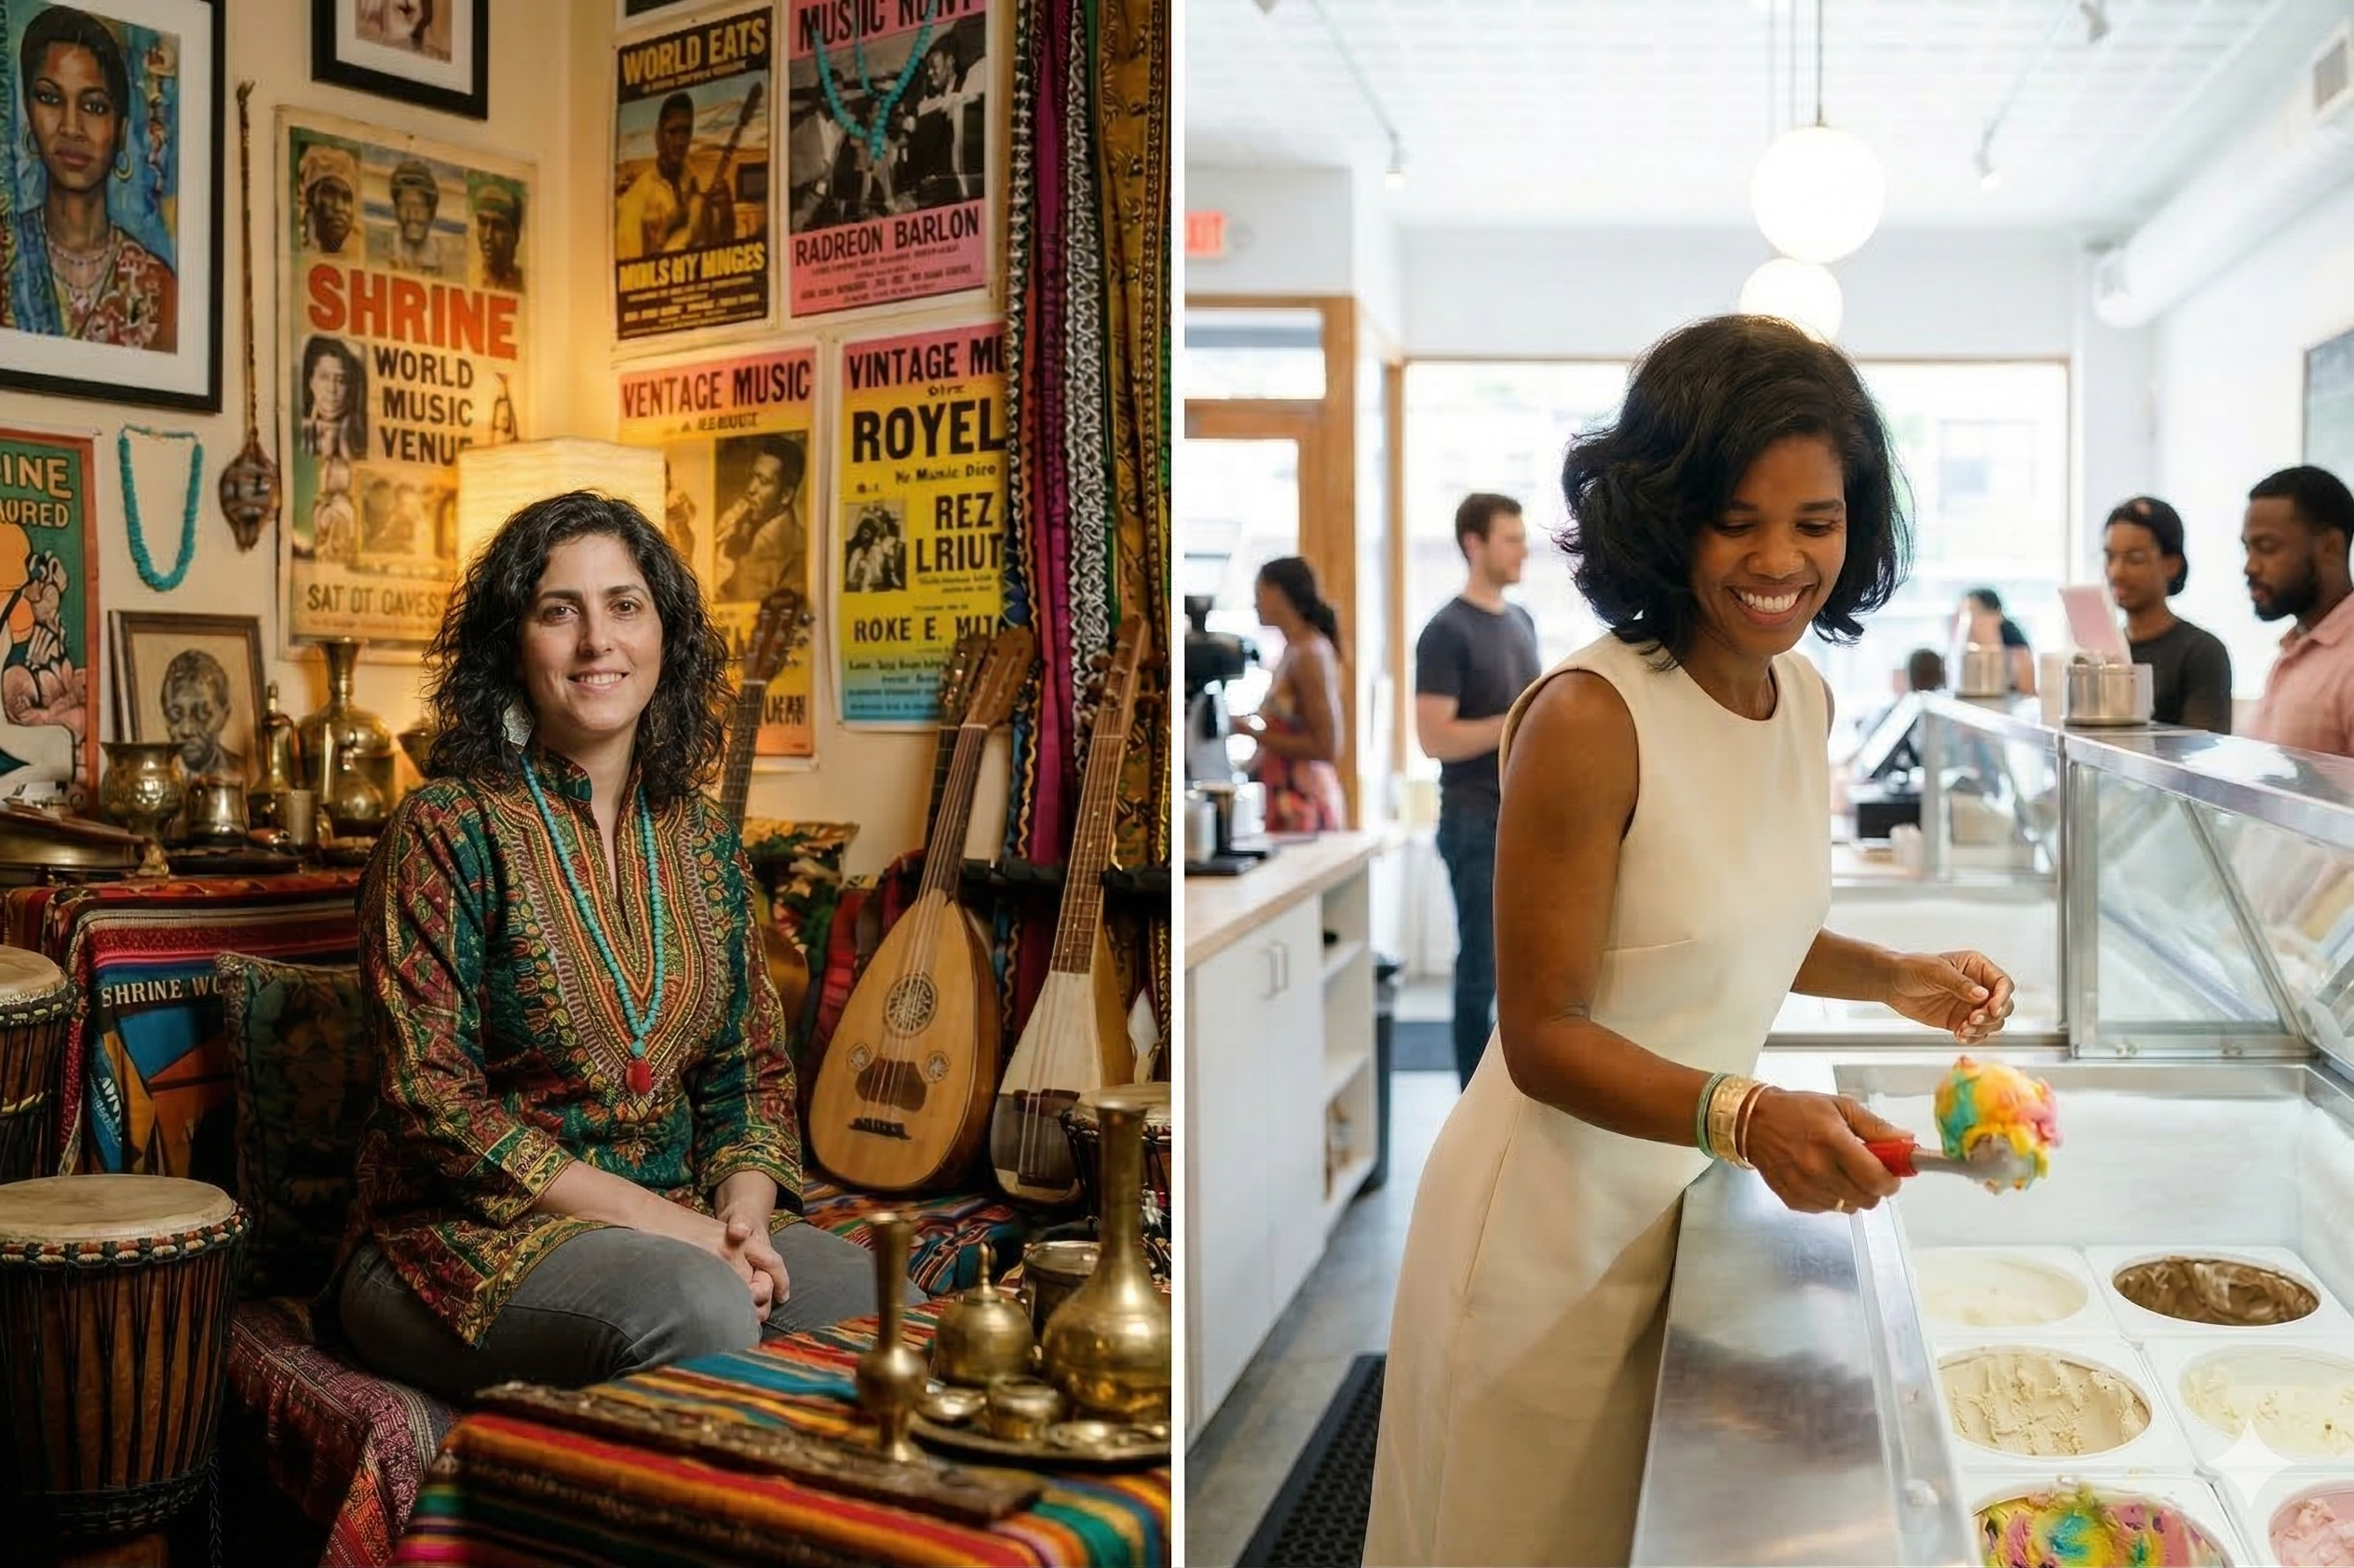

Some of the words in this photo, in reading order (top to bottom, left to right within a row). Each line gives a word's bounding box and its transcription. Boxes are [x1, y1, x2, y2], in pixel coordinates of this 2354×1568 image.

[623, 35, 701, 86] WORLD
[710, 18, 765, 64] EATS
[796, 223, 884, 267] RADREON
[894, 206, 979, 250] BARLON
[307, 263, 518, 361] SHRINE
[373, 345, 474, 390] WORLD
[733, 358, 811, 407] MUSIC
[848, 341, 959, 390] VINTAGE
[383, 386, 474, 428] MUSIC
[852, 398, 1008, 463] ROYEL
[0, 498, 70, 529] URED
[935, 492, 994, 531] REZ
[915, 533, 1004, 574] LRIUT
[306, 584, 345, 613] SAT
[101, 979, 183, 1008] SHRINE
